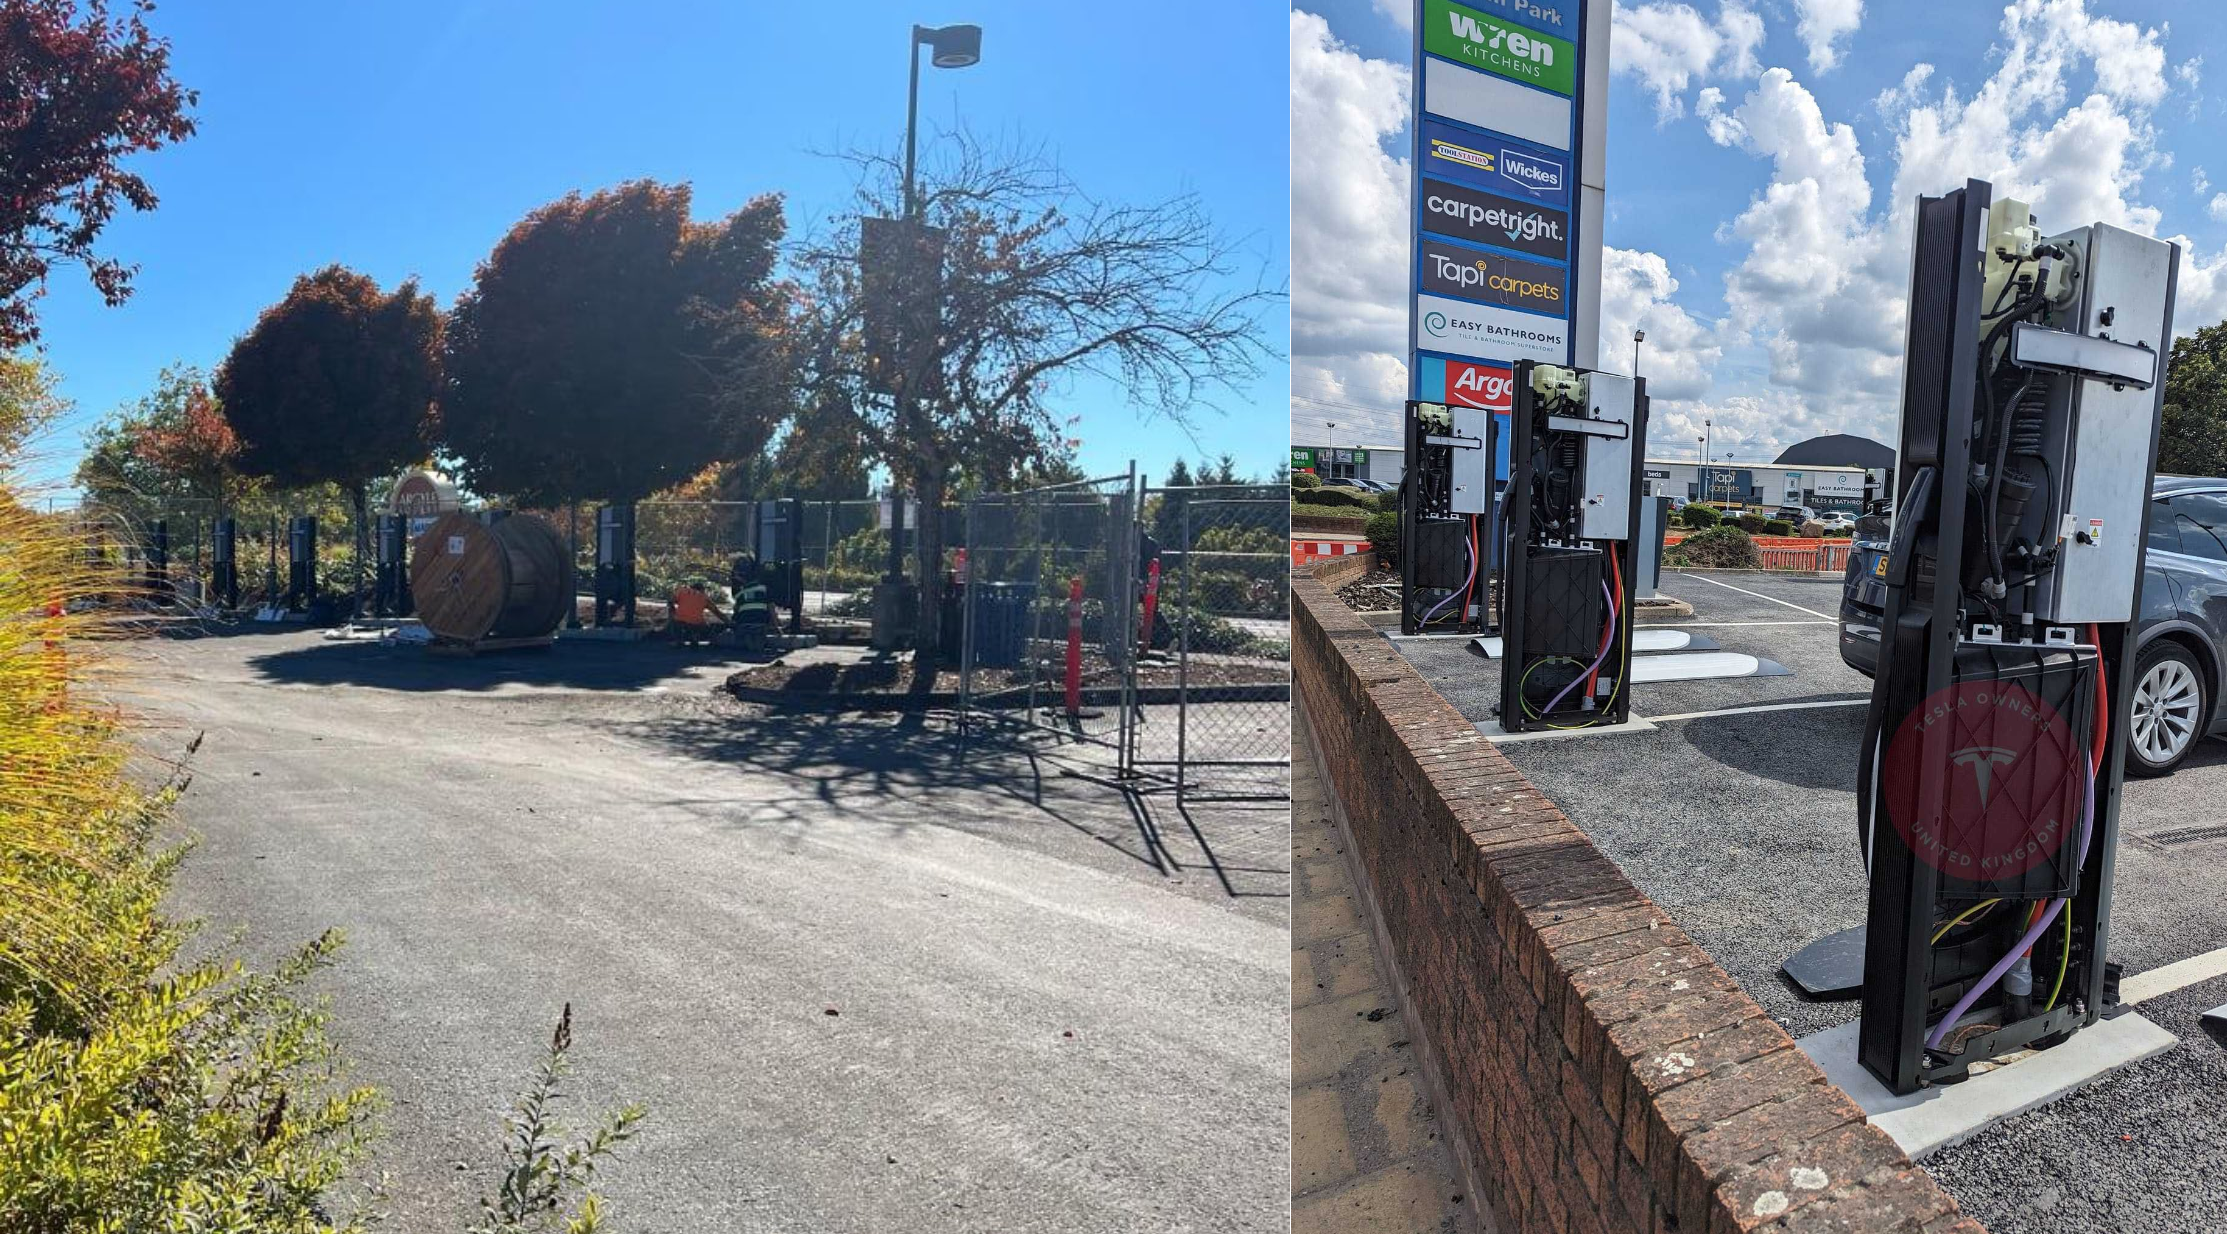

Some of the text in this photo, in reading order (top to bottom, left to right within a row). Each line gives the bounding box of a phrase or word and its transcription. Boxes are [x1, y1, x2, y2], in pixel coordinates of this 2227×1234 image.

[1515, 0, 1562, 26] Park
[1463, 44, 1541, 77] KITCHENS
[1439, 146, 1488, 165] TOOLSTATION
[1505, 159, 1558, 185] Wickes
[1429, 254, 1559, 300] Tapi carpets
[1451, 319, 1561, 344] EASY BATHROOMS
[1481, 337, 1515, 347] BATHROOM
[1517, 342, 1554, 353] SUPERSTORE
[1709, 485, 1739, 493] carpets
[1712, 470, 1736, 485] Tapi
